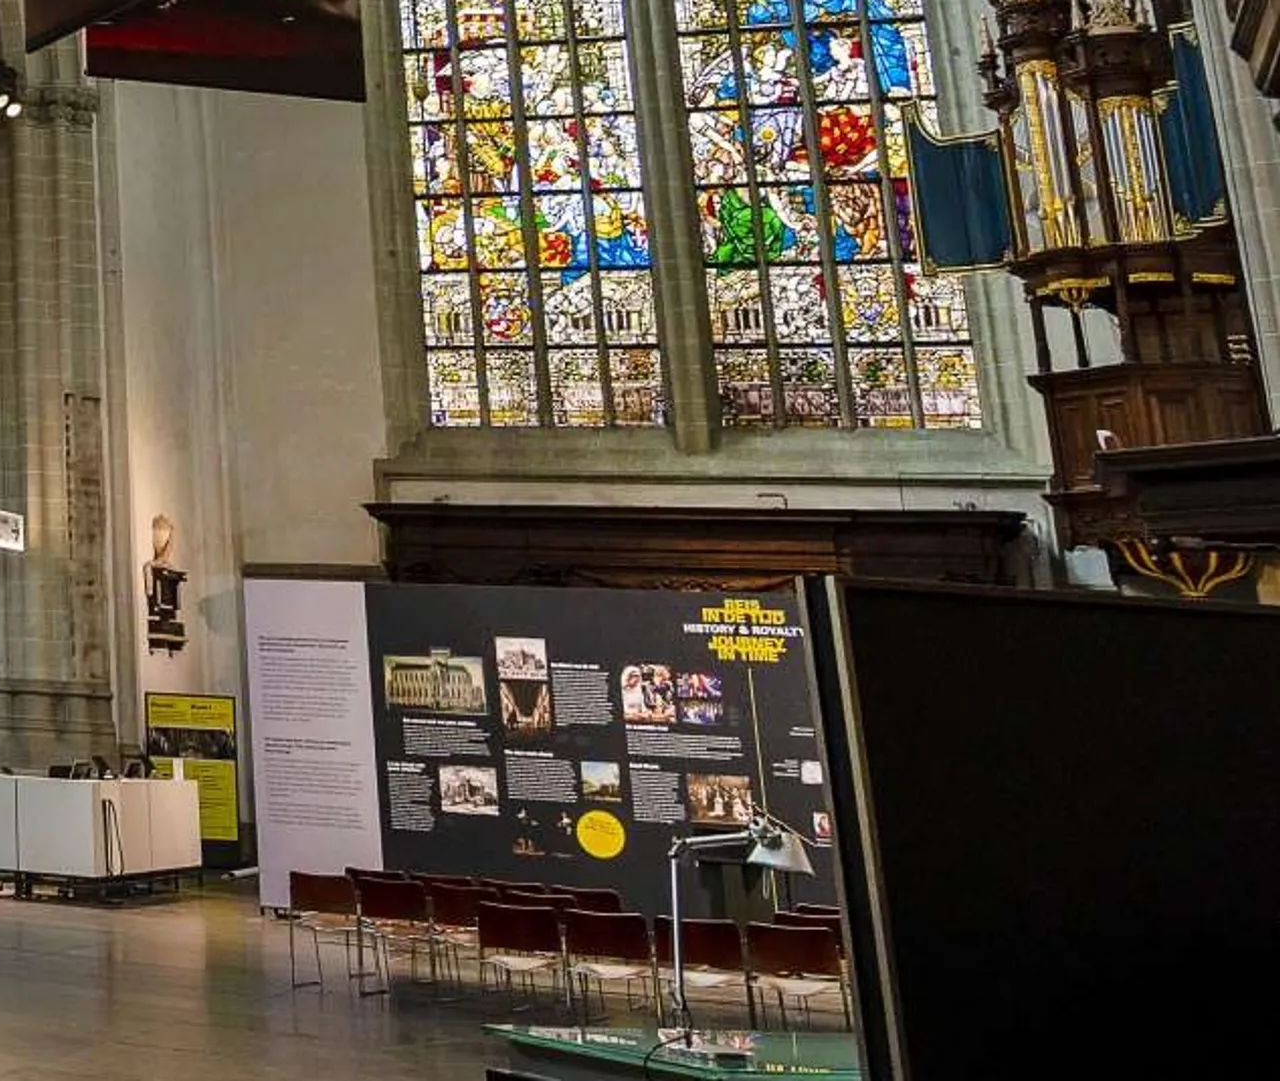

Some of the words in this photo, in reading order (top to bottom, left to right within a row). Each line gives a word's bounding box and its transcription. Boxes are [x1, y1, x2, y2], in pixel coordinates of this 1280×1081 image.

[702, 608, 720, 622] IN
[725, 610, 745, 623] DE
[750, 610, 785, 625] TIJD
[683, 623, 735, 634] HISTORY
[739, 625, 749, 635] &
[708, 636, 786, 652] JOURNEY
[717, 648, 736, 660] IN
[742, 650, 779, 662] TIME
